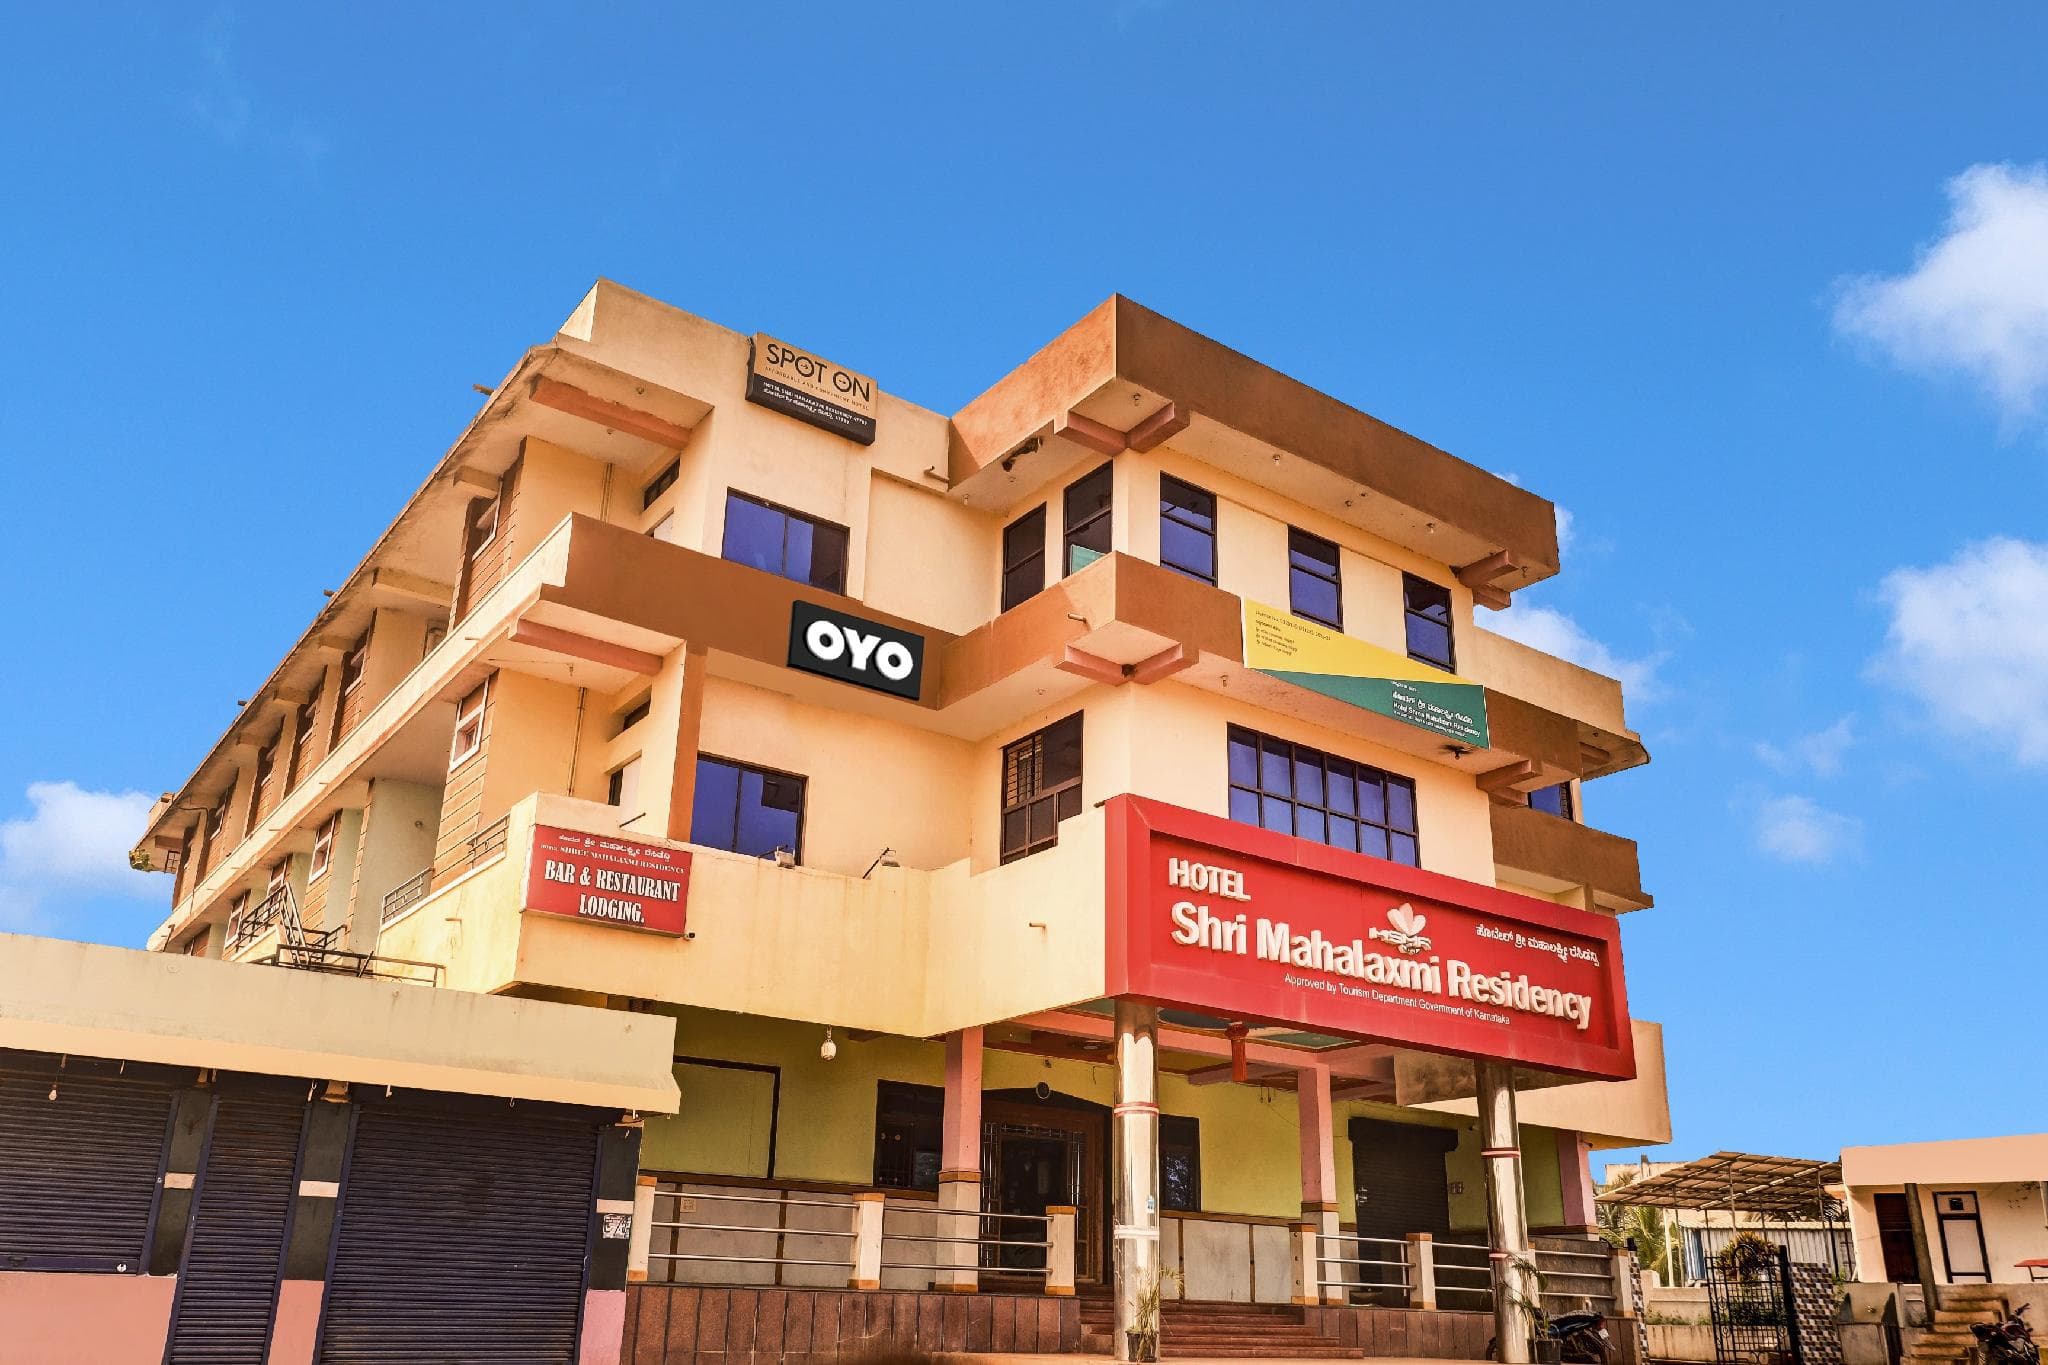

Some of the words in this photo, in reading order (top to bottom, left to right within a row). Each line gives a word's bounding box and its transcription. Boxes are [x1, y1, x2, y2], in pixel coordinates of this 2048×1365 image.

[766, 343, 827, 383] SPOT
[833, 371, 870, 402] ON
[806, 620, 914, 680] OYO
[544, 859, 576, 884] BAR
[579, 866, 592, 887] &
[595, 868, 681, 902] RESTAURANT
[1168, 857, 1252, 902] HOTEL
[578, 893, 645, 923] LODGING.
[1170, 901, 1248, 955] Shri
[1256, 918, 1442, 995] Mahalaxmi
[1446, 959, 1592, 1031] Residency
[1284, 973, 1325, 990] Approved
[1326, 979, 1338, 995] by
[1338, 982, 1371, 999] Tourism
[1372, 989, 1418, 1008] Department
[1418, 998, 1465, 1017] Government
[1465, 1007, 1474, 1018] of
[1474, 1008, 1511, 1025] Karnataka
